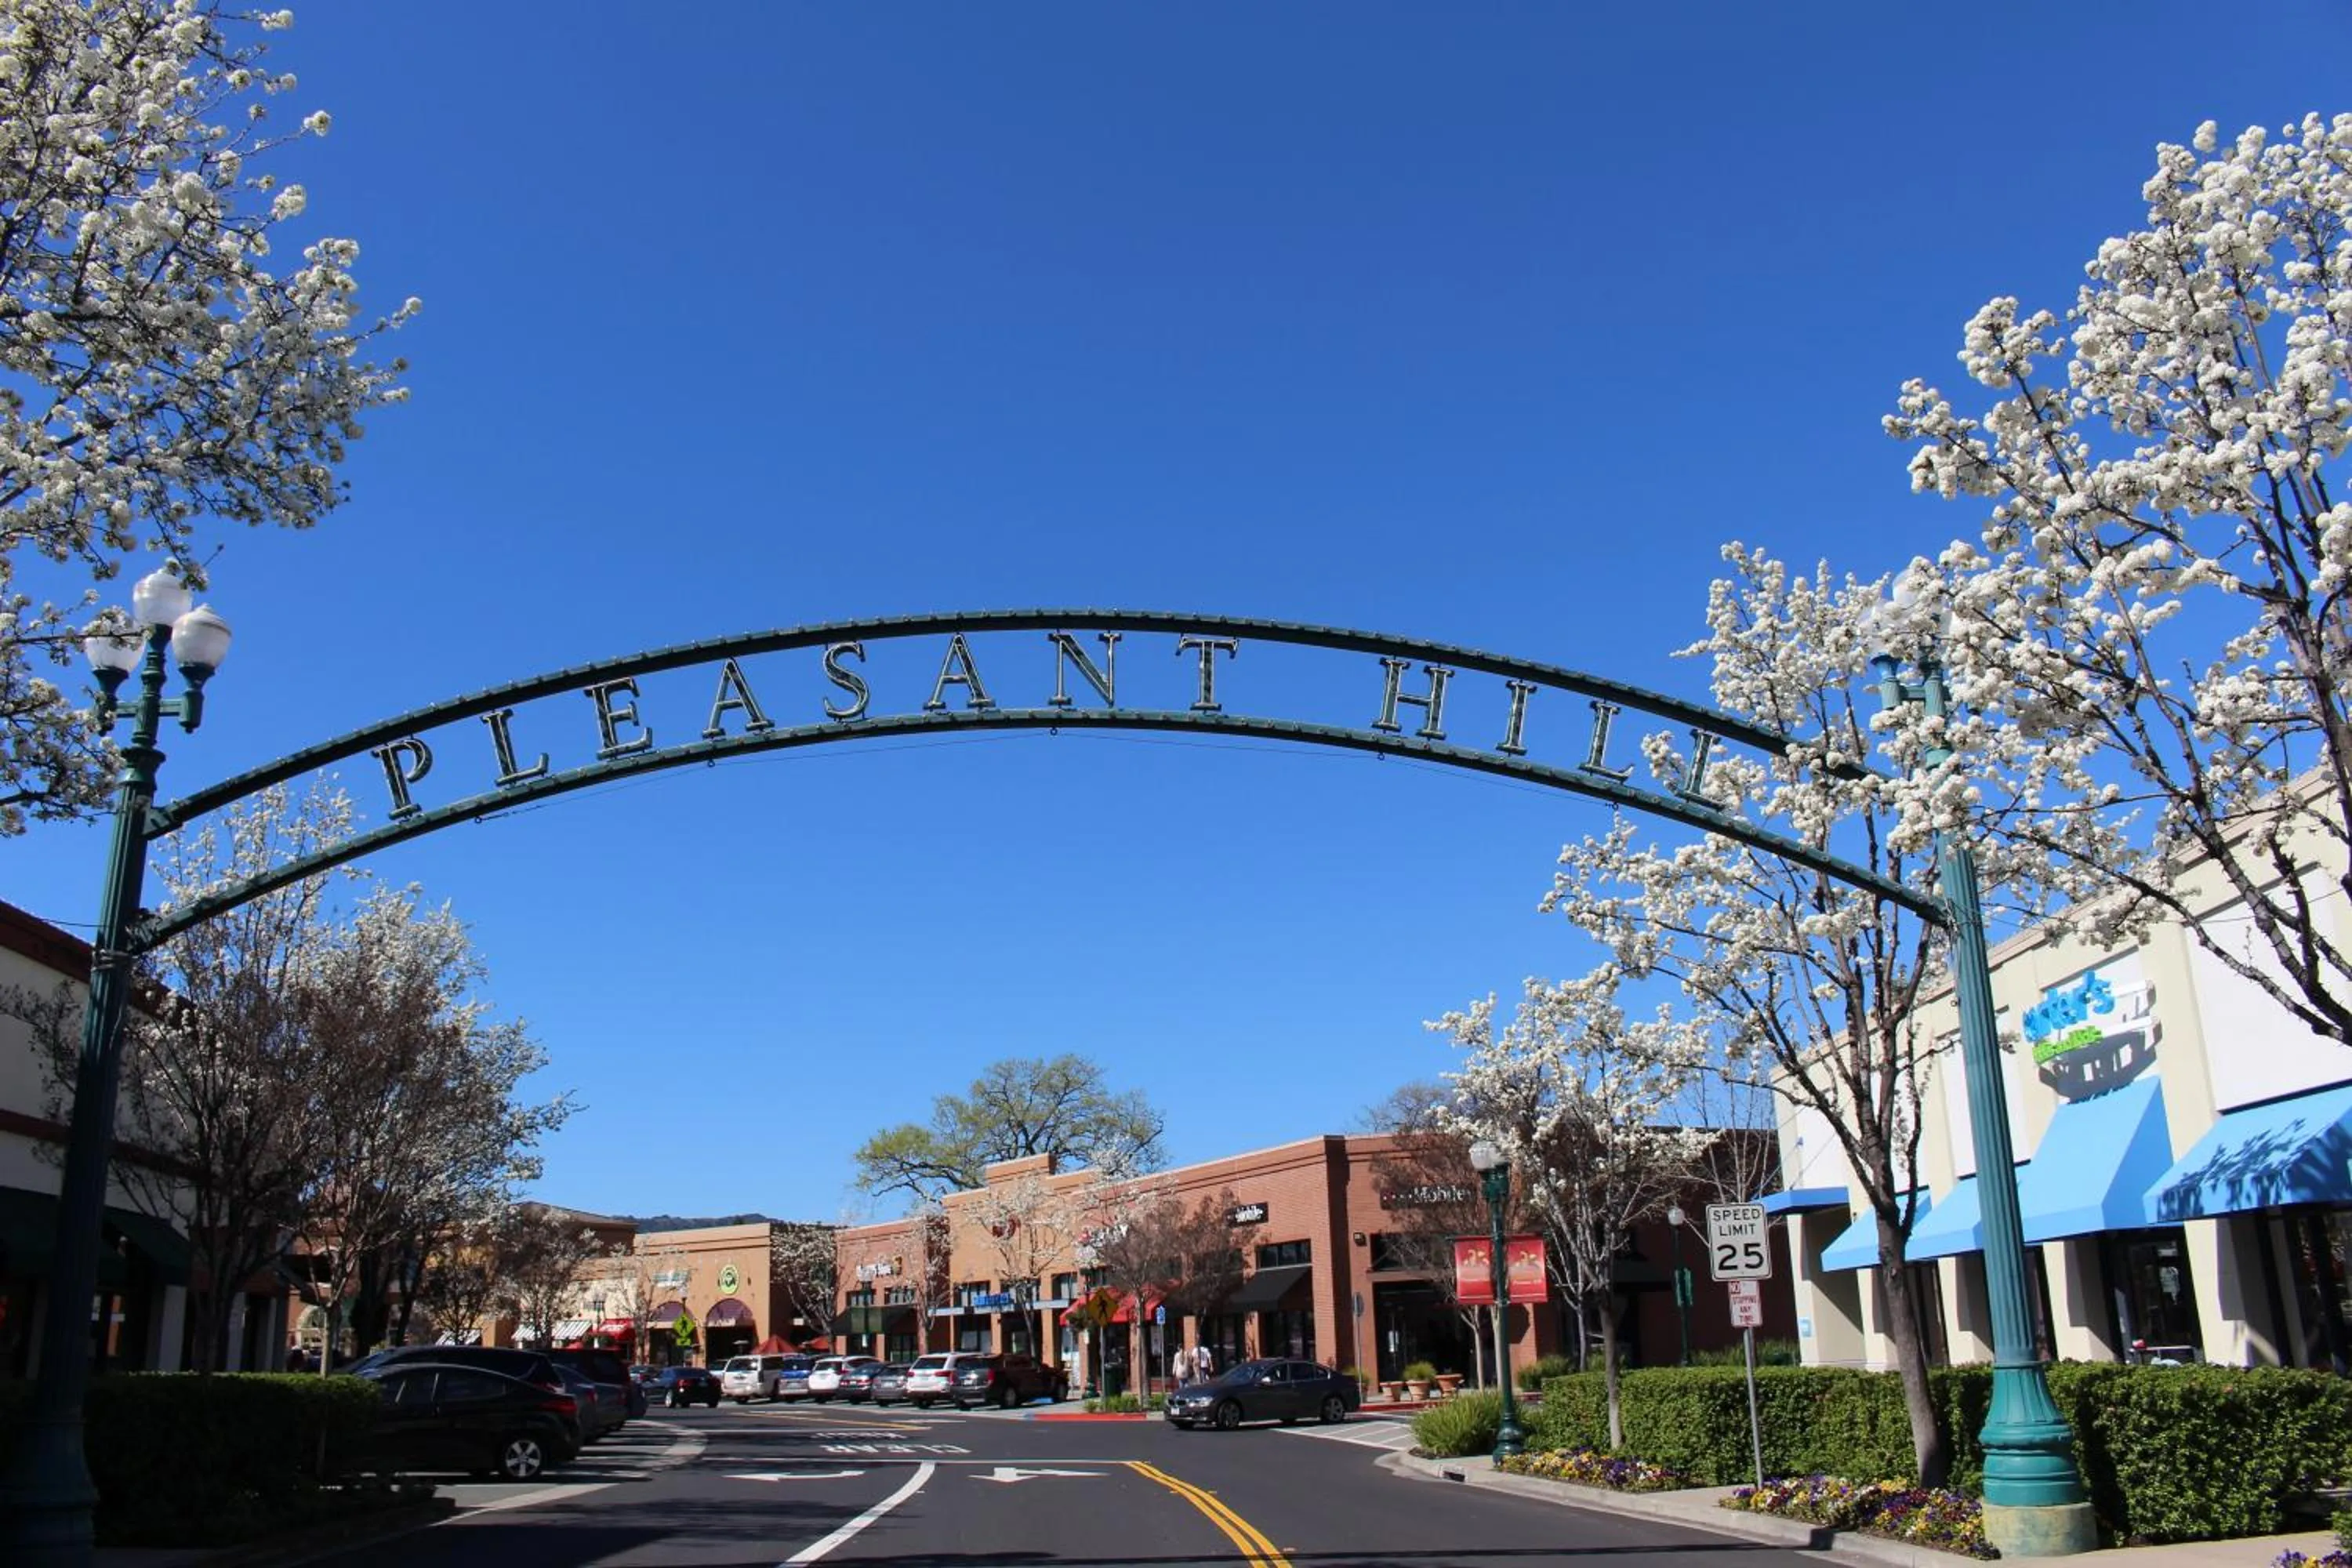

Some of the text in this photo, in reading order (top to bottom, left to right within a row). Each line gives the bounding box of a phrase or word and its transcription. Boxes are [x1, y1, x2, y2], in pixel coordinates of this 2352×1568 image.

[371, 632, 1726, 820] PLEASANT HILL
[1712, 1208, 1761, 1221] SPEED
[1719, 1224, 1756, 1236] LIMIT
[1717, 1243, 1764, 1271] 25
